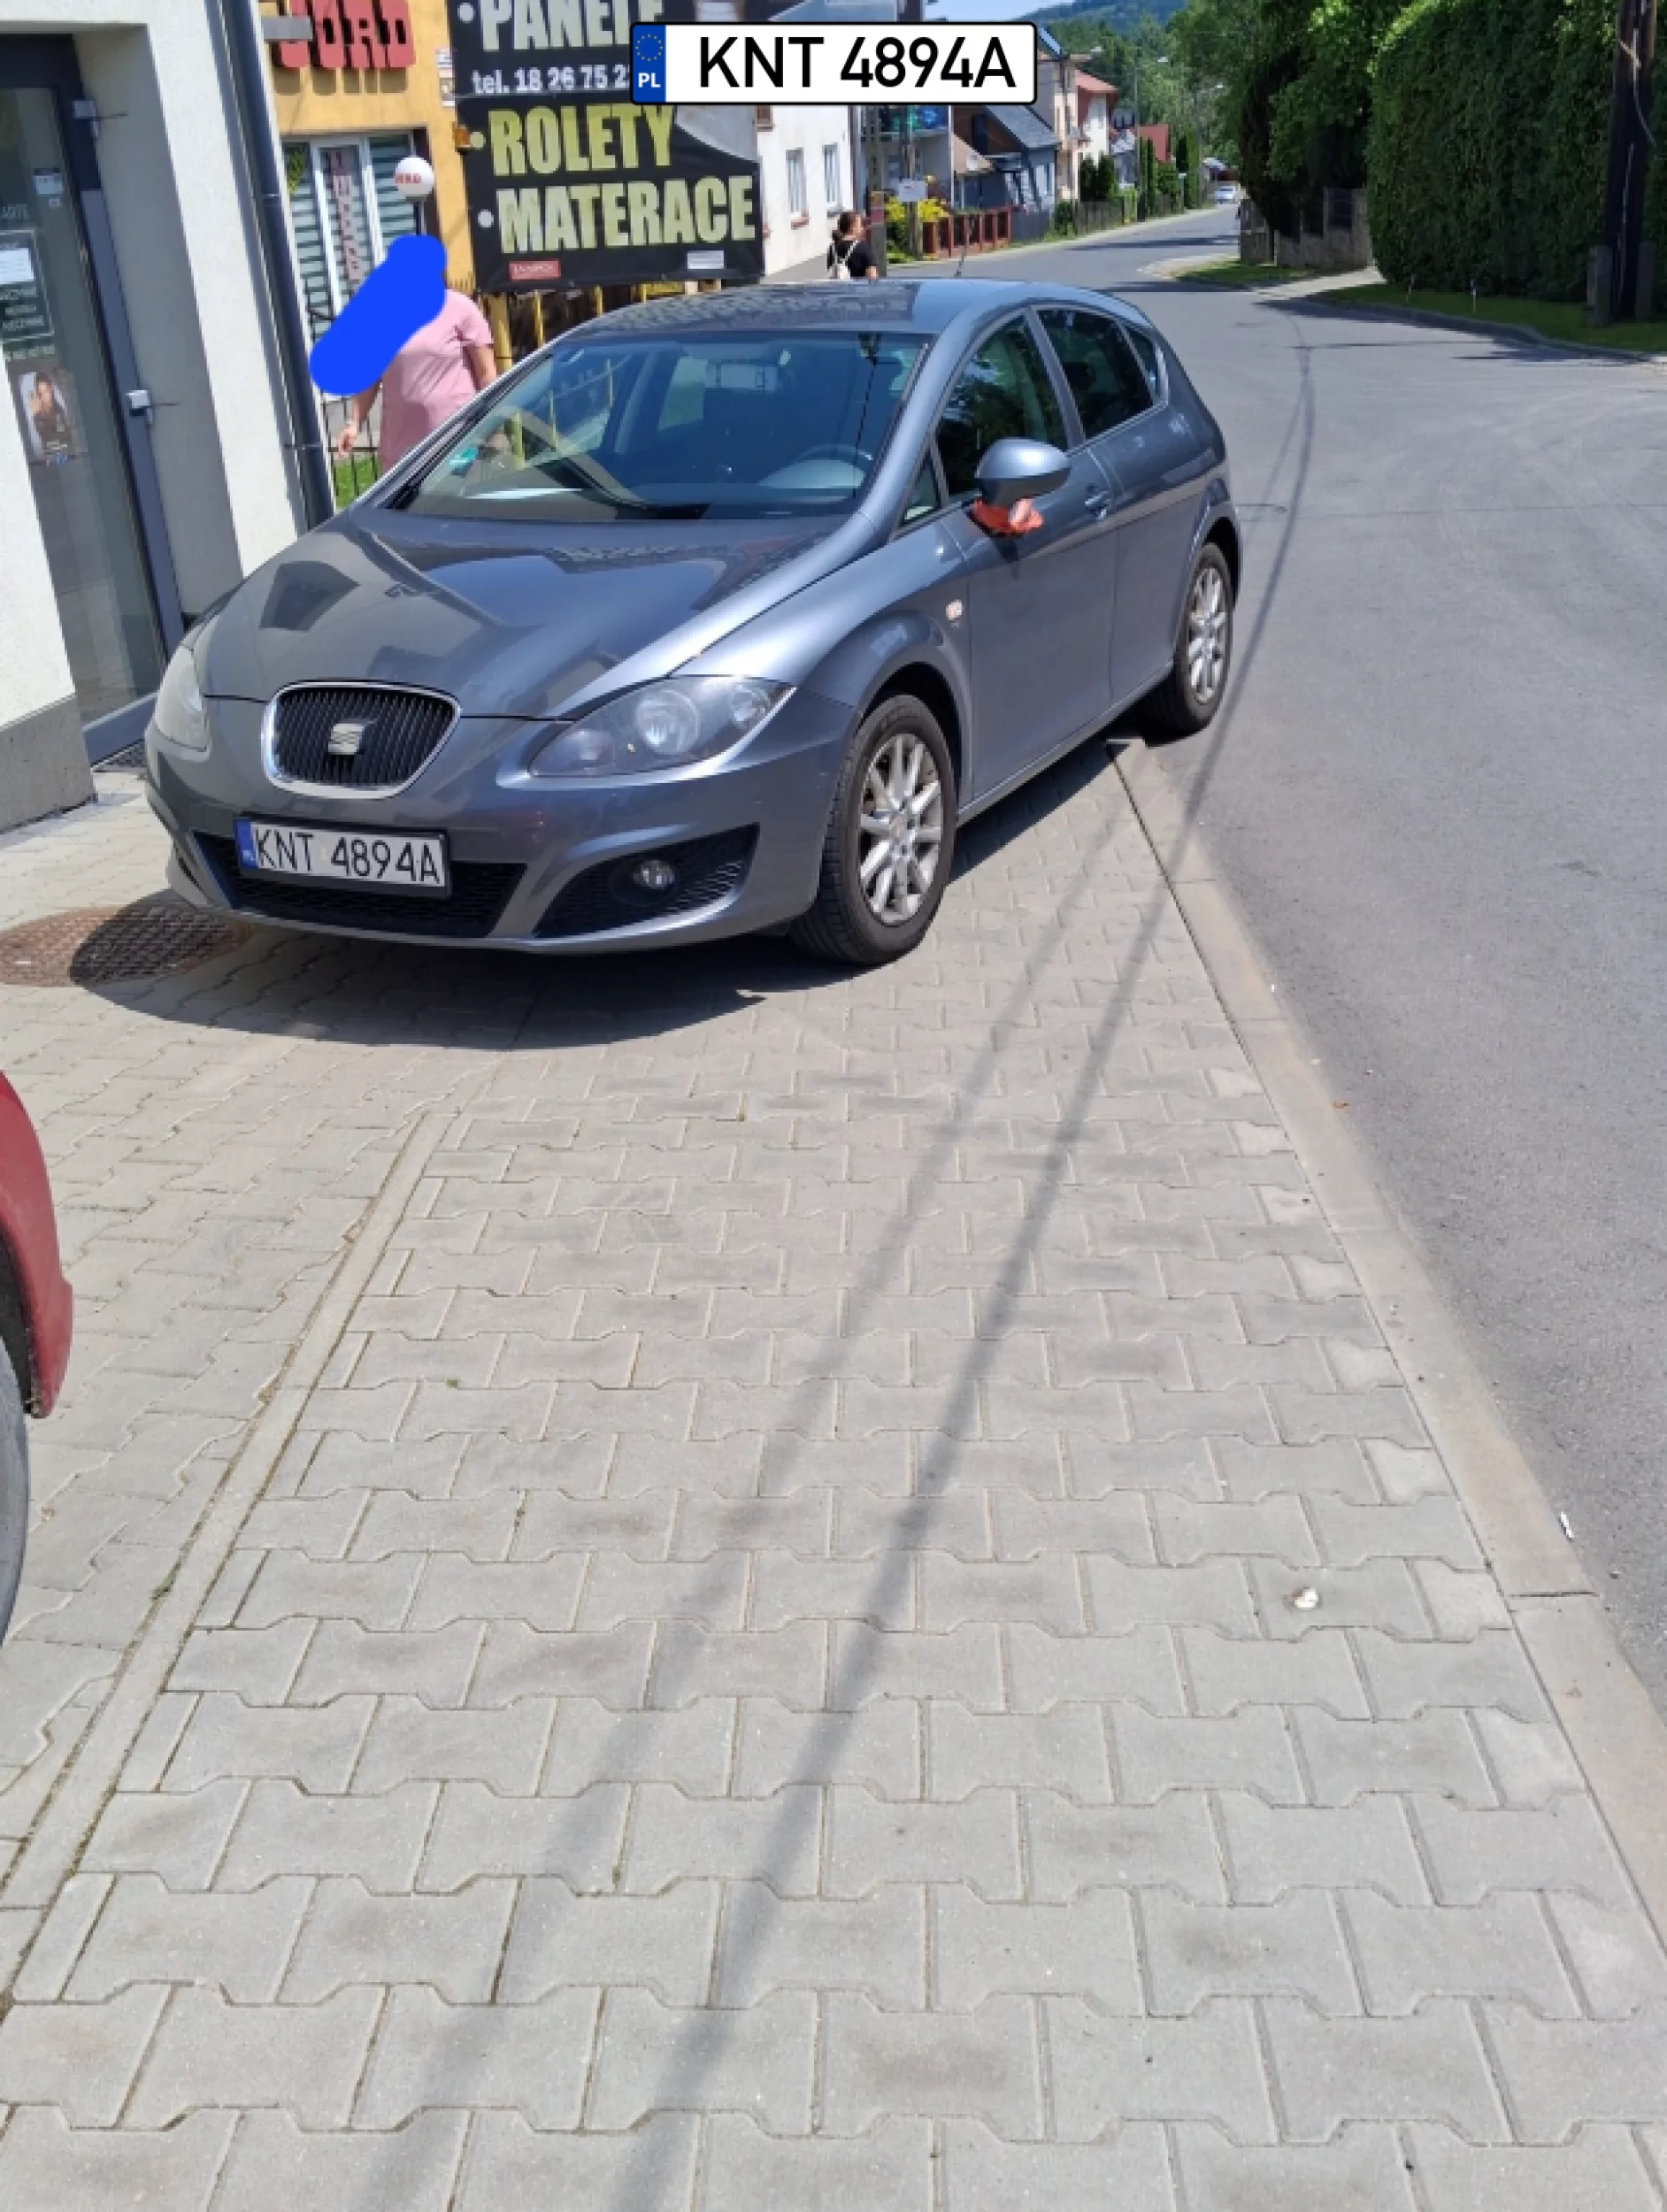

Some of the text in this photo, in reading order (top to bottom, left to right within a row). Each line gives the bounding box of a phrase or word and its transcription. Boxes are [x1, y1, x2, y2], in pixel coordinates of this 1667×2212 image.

[472, 69, 511, 95] tel.
[514, 66, 543, 92] 18
[547, 65, 576, 92] 26
[579, 63, 609, 90] 75
[613, 63, 632, 89] 2
[488, 103, 677, 177] ROLETY
[495, 175, 756, 255] MATERACE
[255, 828, 441, 884] KNT 4894A
